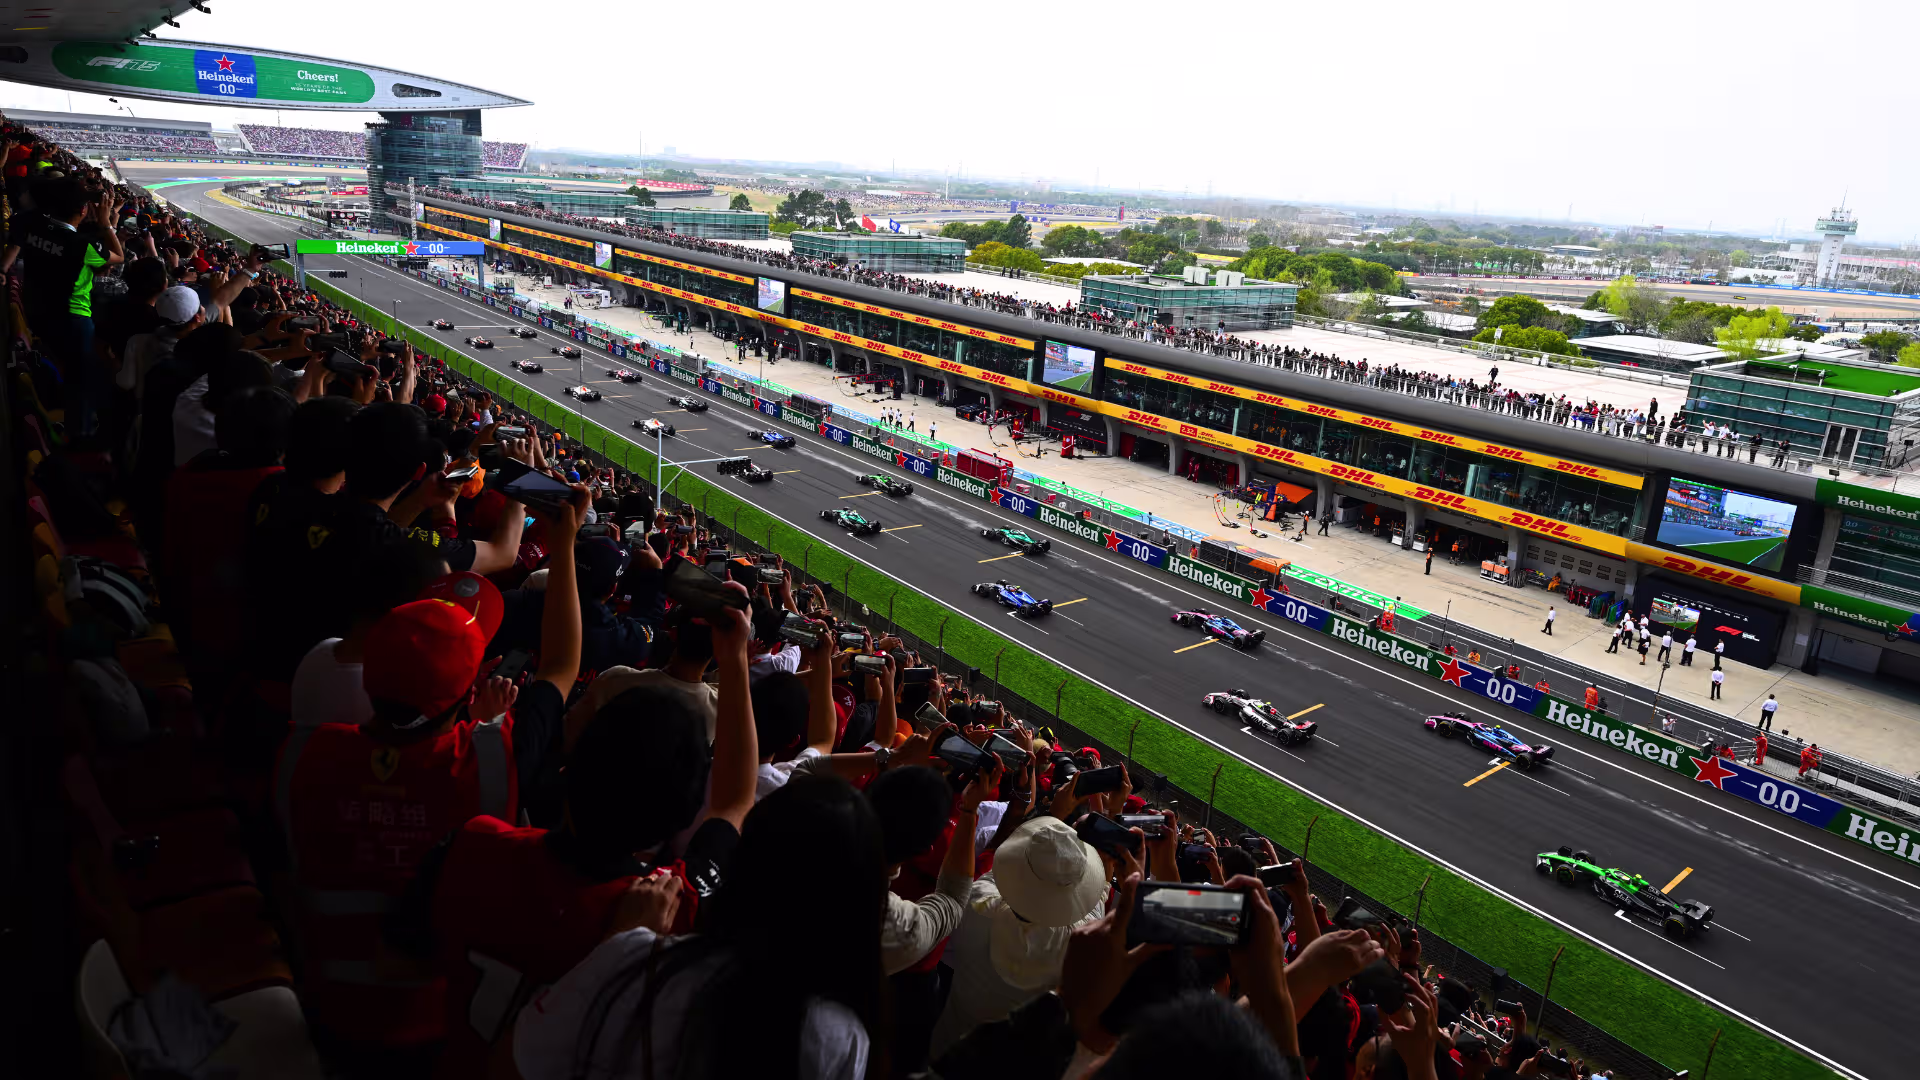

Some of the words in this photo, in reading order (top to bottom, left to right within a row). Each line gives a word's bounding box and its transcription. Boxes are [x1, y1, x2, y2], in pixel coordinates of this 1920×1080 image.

[198, 70, 252, 84] Heineken
[297, 70, 338, 83] Cheers!
[26, 232, 64, 257] KICK
[336, 242, 398, 253] Heineken
[682, 292, 694, 300] DHL
[704, 298, 718, 306] DHL
[726, 304, 741, 313] DHL
[758, 314, 777, 324] DHL
[803, 324, 821, 334] DHL
[941, 323, 957, 331] DHL
[969, 329, 986, 337] DHL
[833, 332, 852, 344] DHL
[998, 336, 1016, 344] DHL
[866, 341, 887, 352] DHL
[901, 350, 924, 362] DHL
[940, 361, 963, 374] DHL
[1125, 364, 1148, 375] DHL
[981, 372, 1007, 385] DHL
[1166, 373, 1190, 384] DHL
[1209, 383, 1235, 394] DHL
[1042, 390, 1080, 407] DHL
[1256, 393, 1285, 406] DHL
[1307, 405, 1338, 418] DHL
[1127, 411, 1163, 428] DHL
[1360, 417, 1393, 430] DHL
[1420, 430, 1456, 445] DHL
[1254, 444, 1297, 464] DHL
[1484, 445, 1525, 460] DHL
[1328, 464, 1378, 487] DHL
[1556, 461, 1599, 478] DHL
[1414, 487, 1468, 511] DHL
[1838, 495, 1918, 520] Heineken
[1510, 512, 1570, 539] DHL
[626, 352, 648, 366] Heineken
[671, 367, 696, 384] Heineken
[722, 386, 750, 407] Heineken
[782, 410, 815, 432] Heineken
[852, 436, 892, 462] Heineken
[937, 468, 985, 498] Heineken
[1040, 506, 1099, 542] Heineken
[1168, 555, 1243, 599] Heineken
[1331, 618, 1429, 672] Heineken
[1546, 698, 1678, 769] Heineken
[1663, 556, 1757, 592] DHL
[1814, 601, 1888, 628] Heineken
